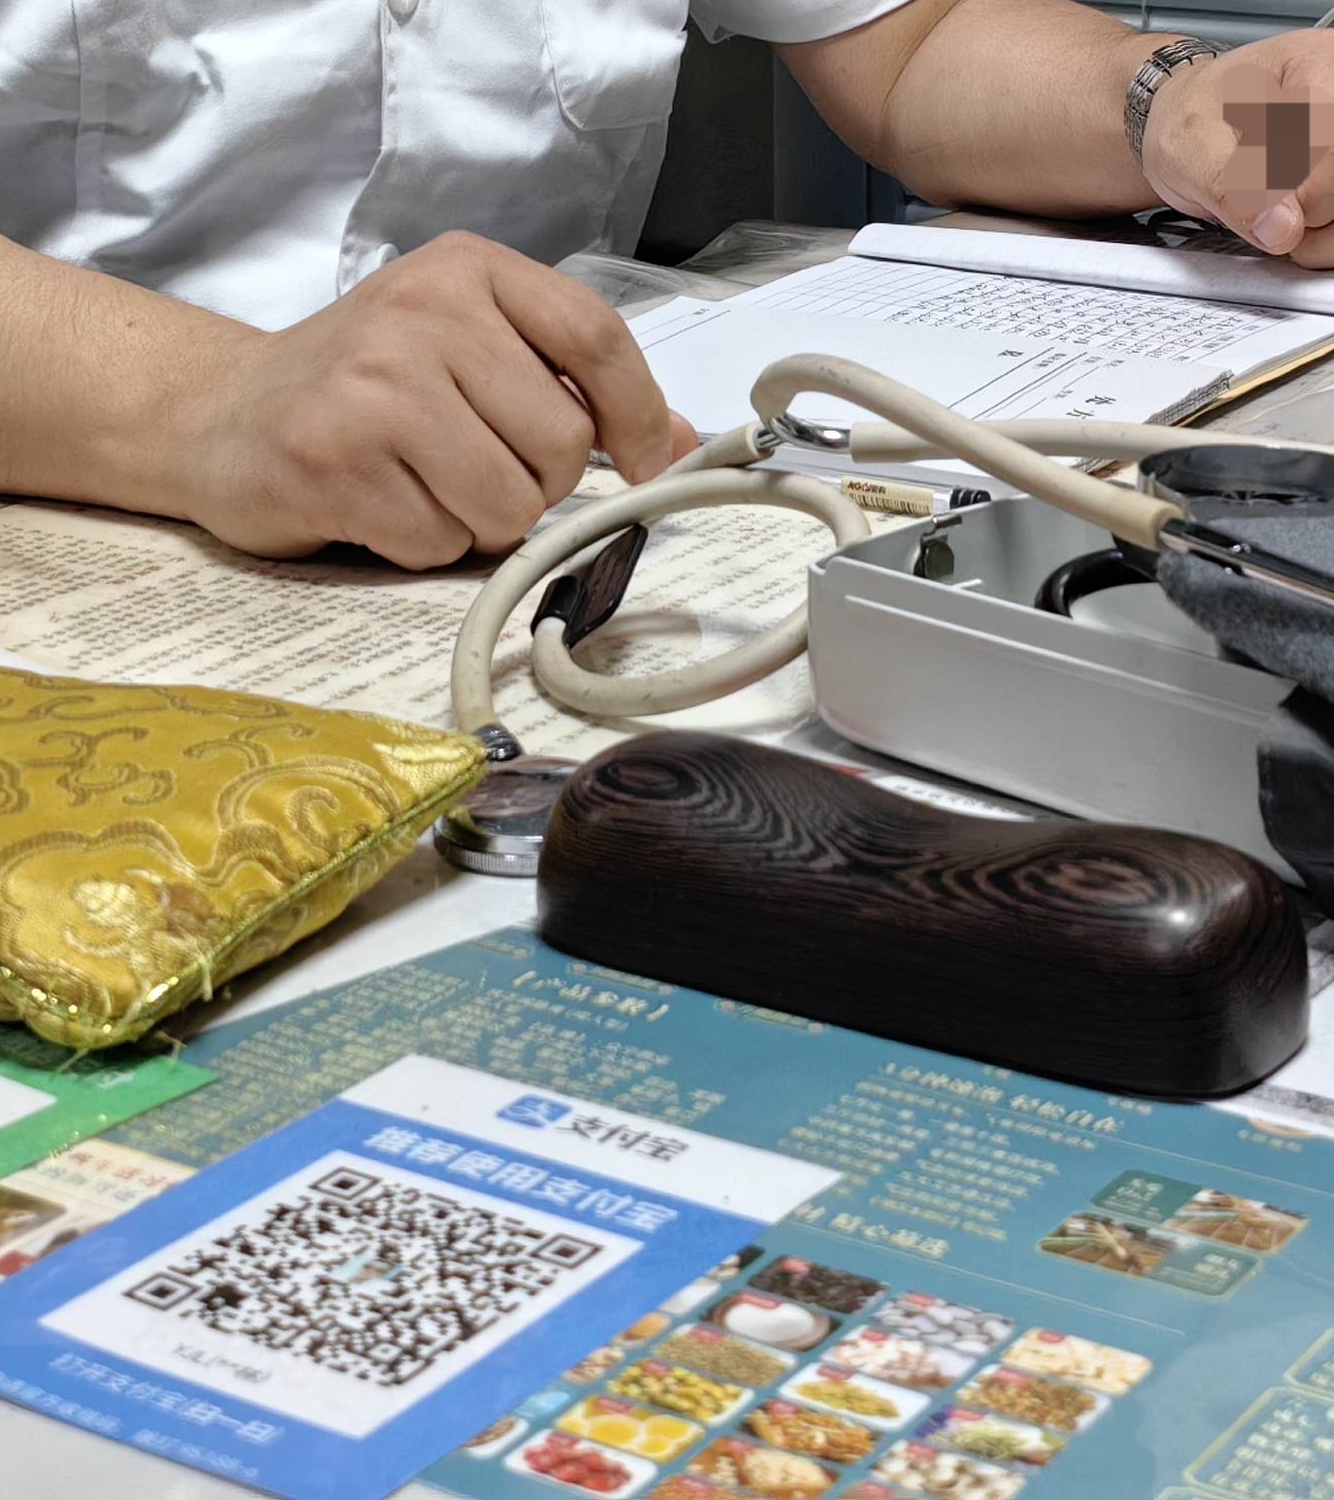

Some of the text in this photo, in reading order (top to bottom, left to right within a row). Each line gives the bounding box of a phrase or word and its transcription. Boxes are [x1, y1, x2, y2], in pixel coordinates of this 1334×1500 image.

[555, 1113, 691, 1163] 支付宝
[364, 1126, 679, 1234] 推荐使用支付宝
